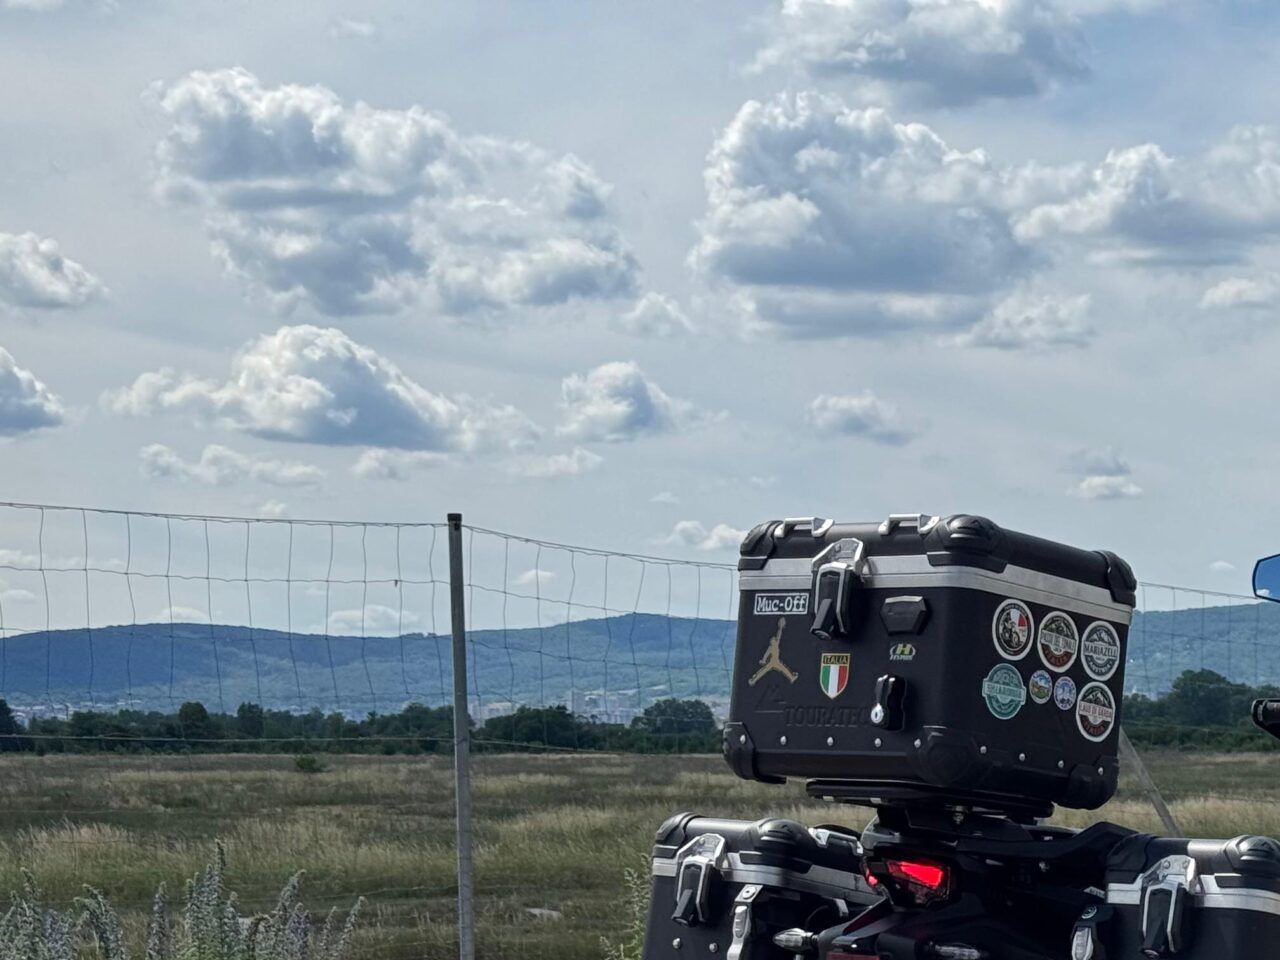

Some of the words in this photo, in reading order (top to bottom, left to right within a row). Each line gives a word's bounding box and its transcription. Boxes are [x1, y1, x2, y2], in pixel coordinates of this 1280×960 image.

[757, 596, 807, 611] Muc-Off
[1084, 642, 1117, 657] MARIAZELL
[823, 655, 848, 664] ITALIA
[784, 705, 872, 727] TOURATEC
